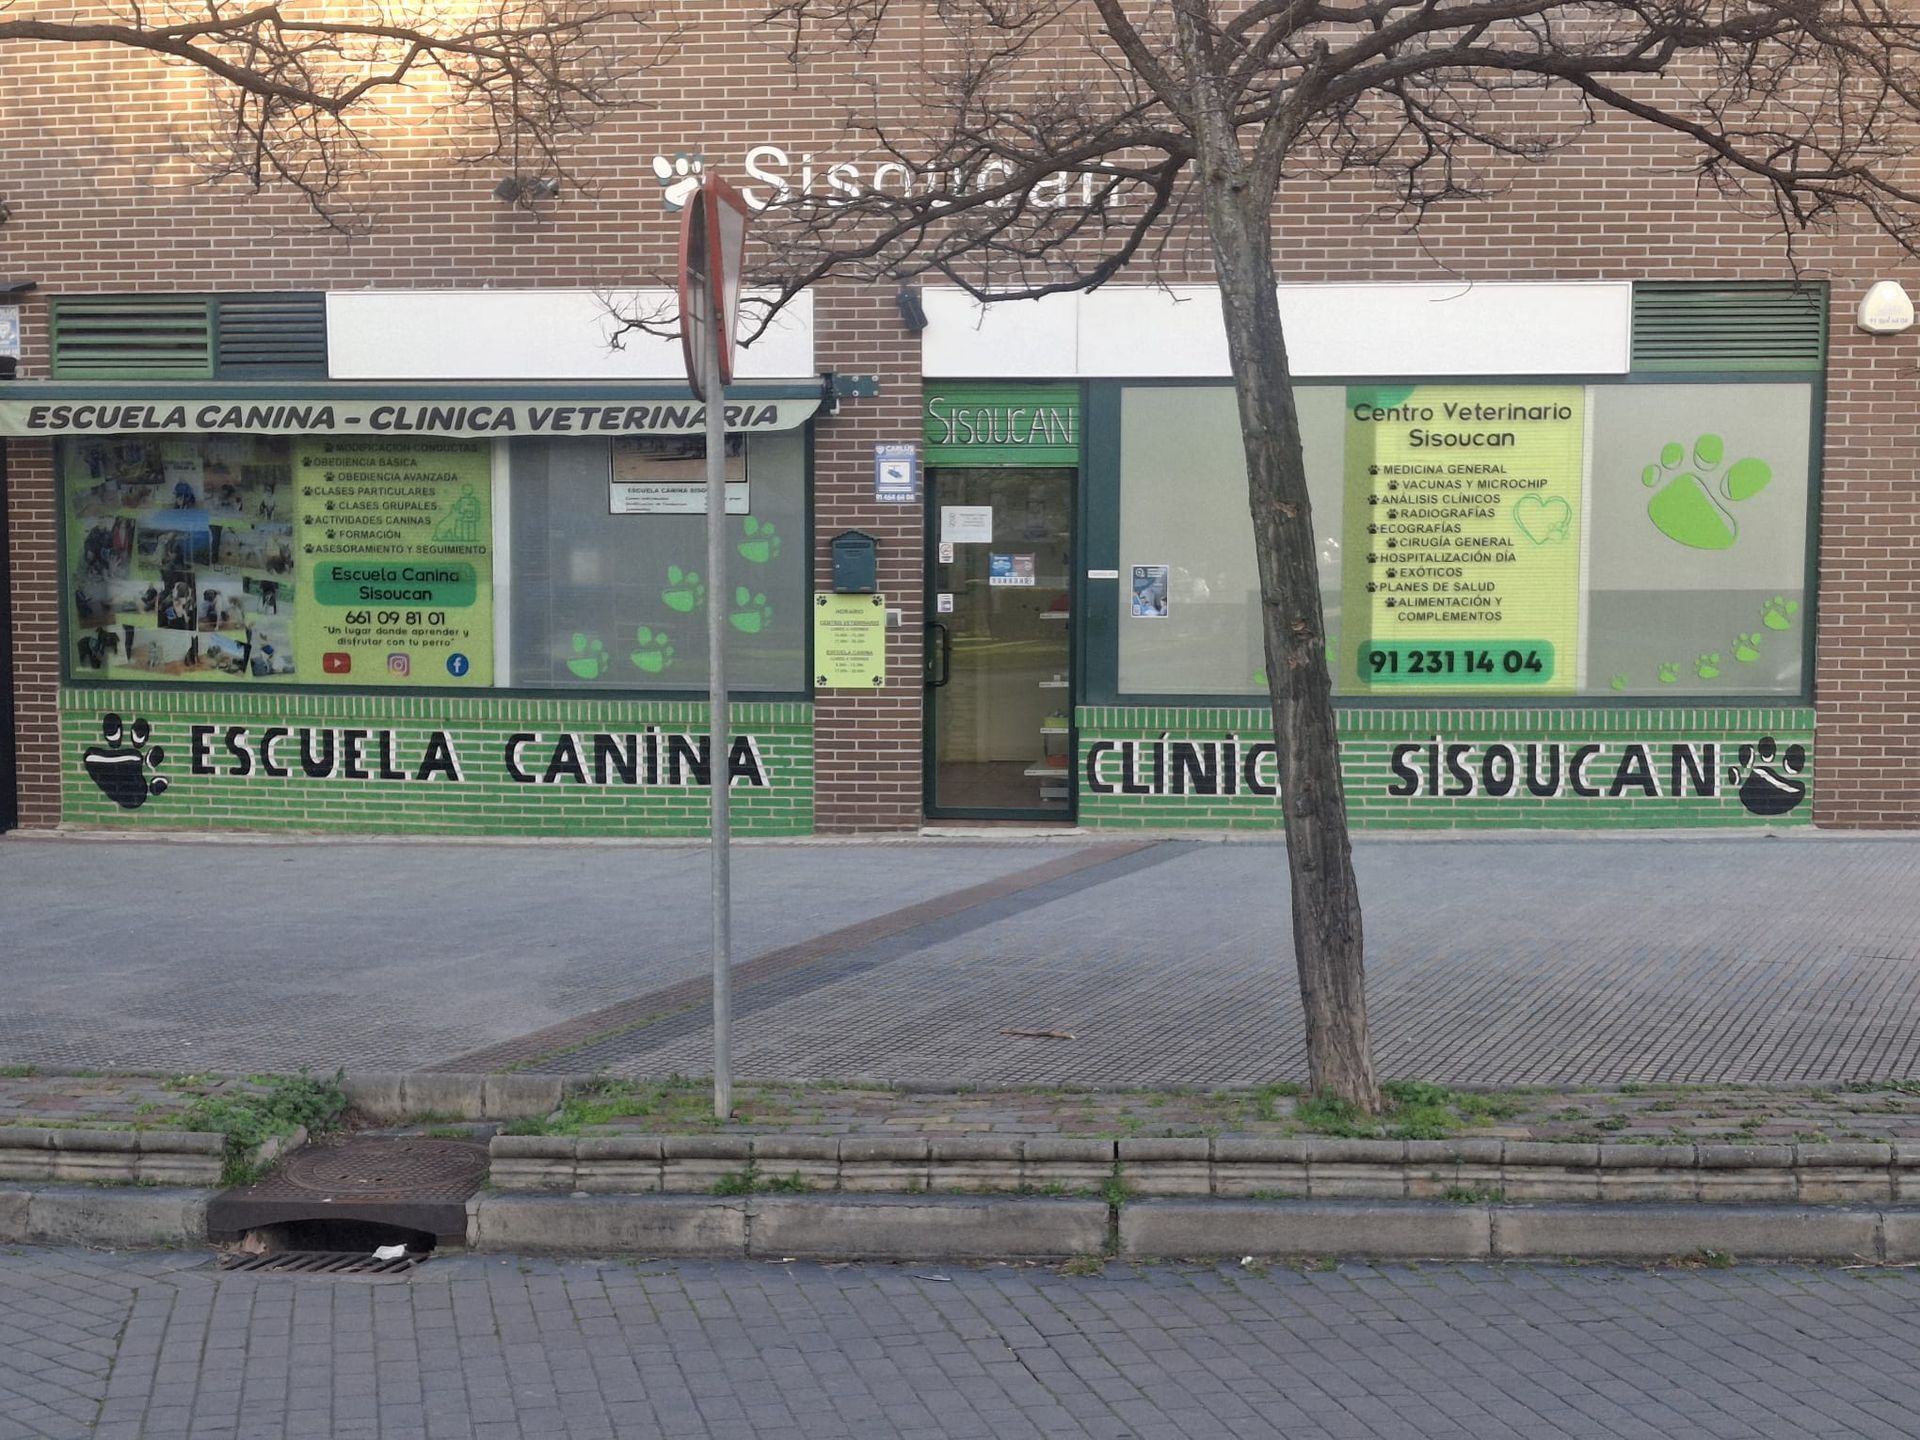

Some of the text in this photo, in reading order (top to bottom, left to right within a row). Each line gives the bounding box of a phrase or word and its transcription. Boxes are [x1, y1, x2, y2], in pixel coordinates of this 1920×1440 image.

[27, 406, 186, 430] ESCUELA
[195, 406, 335, 430] CANINA
[369, 406, 515, 431] CLINICA
[528, 404, 778, 431] VETERINARIA
[1353, 402, 1572, 422] Centro Veterinario
[927, 397, 1072, 445] SISOUCAN
[1408, 428, 1515, 448] Sisoucan
[313, 457, 377, 467] OBEDIENCIA
[1383, 464, 1507, 475] MEDICINA GENERAL
[338, 473, 458, 482] OBEDIENCIA AVANZADA
[1402, 479, 1548, 489] VACUNAS Y MICROCHIP
[314, 487, 435, 496] CLASES PARTICULARES
[1381, 492, 1501, 504] ANÁLISIS CLÍNICOS
[339, 502, 437, 511] CLASES GRUPALES
[1400, 506, 1496, 518] RADIOGRAFÍAS
[314, 516, 431, 525] ACTIVIDADES CANINAS
[339, 529, 401, 539] FORMACIÓN
[1379, 522, 1462, 534] ECOGRAFÍAS
[1399, 535, 1514, 547] CIRUGÍA GENERAL
[315, 544, 487, 555] ASESORAMIENTO Y SEGUIMIENTO
[1379, 551, 1517, 563] HOSPITALIZACIÓN DÍA
[332, 567, 459, 582] Escuela Canina
[1400, 566, 1463, 578] EXÓTICOS
[1379, 582, 1495, 592] PLANES DE SALUD
[359, 586, 432, 601] Sisoucan
[1397, 595, 1503, 607] ALIMENTACIÓN Y
[345, 610, 445, 625] 661 09 81 01
[1397, 611, 1502, 622] COMPLEMENTOS
[344, 627, 371, 637] lugar
[376, 627, 408, 635] donde
[411, 628, 459, 638] aprender
[463, 629, 469, 638] y
[337, 637, 382, 647] disfrutar
[409, 638, 419, 646] tu
[1369, 650, 1543, 673] 91 231 14 04
[191, 725, 465, 782] ESCUELA
